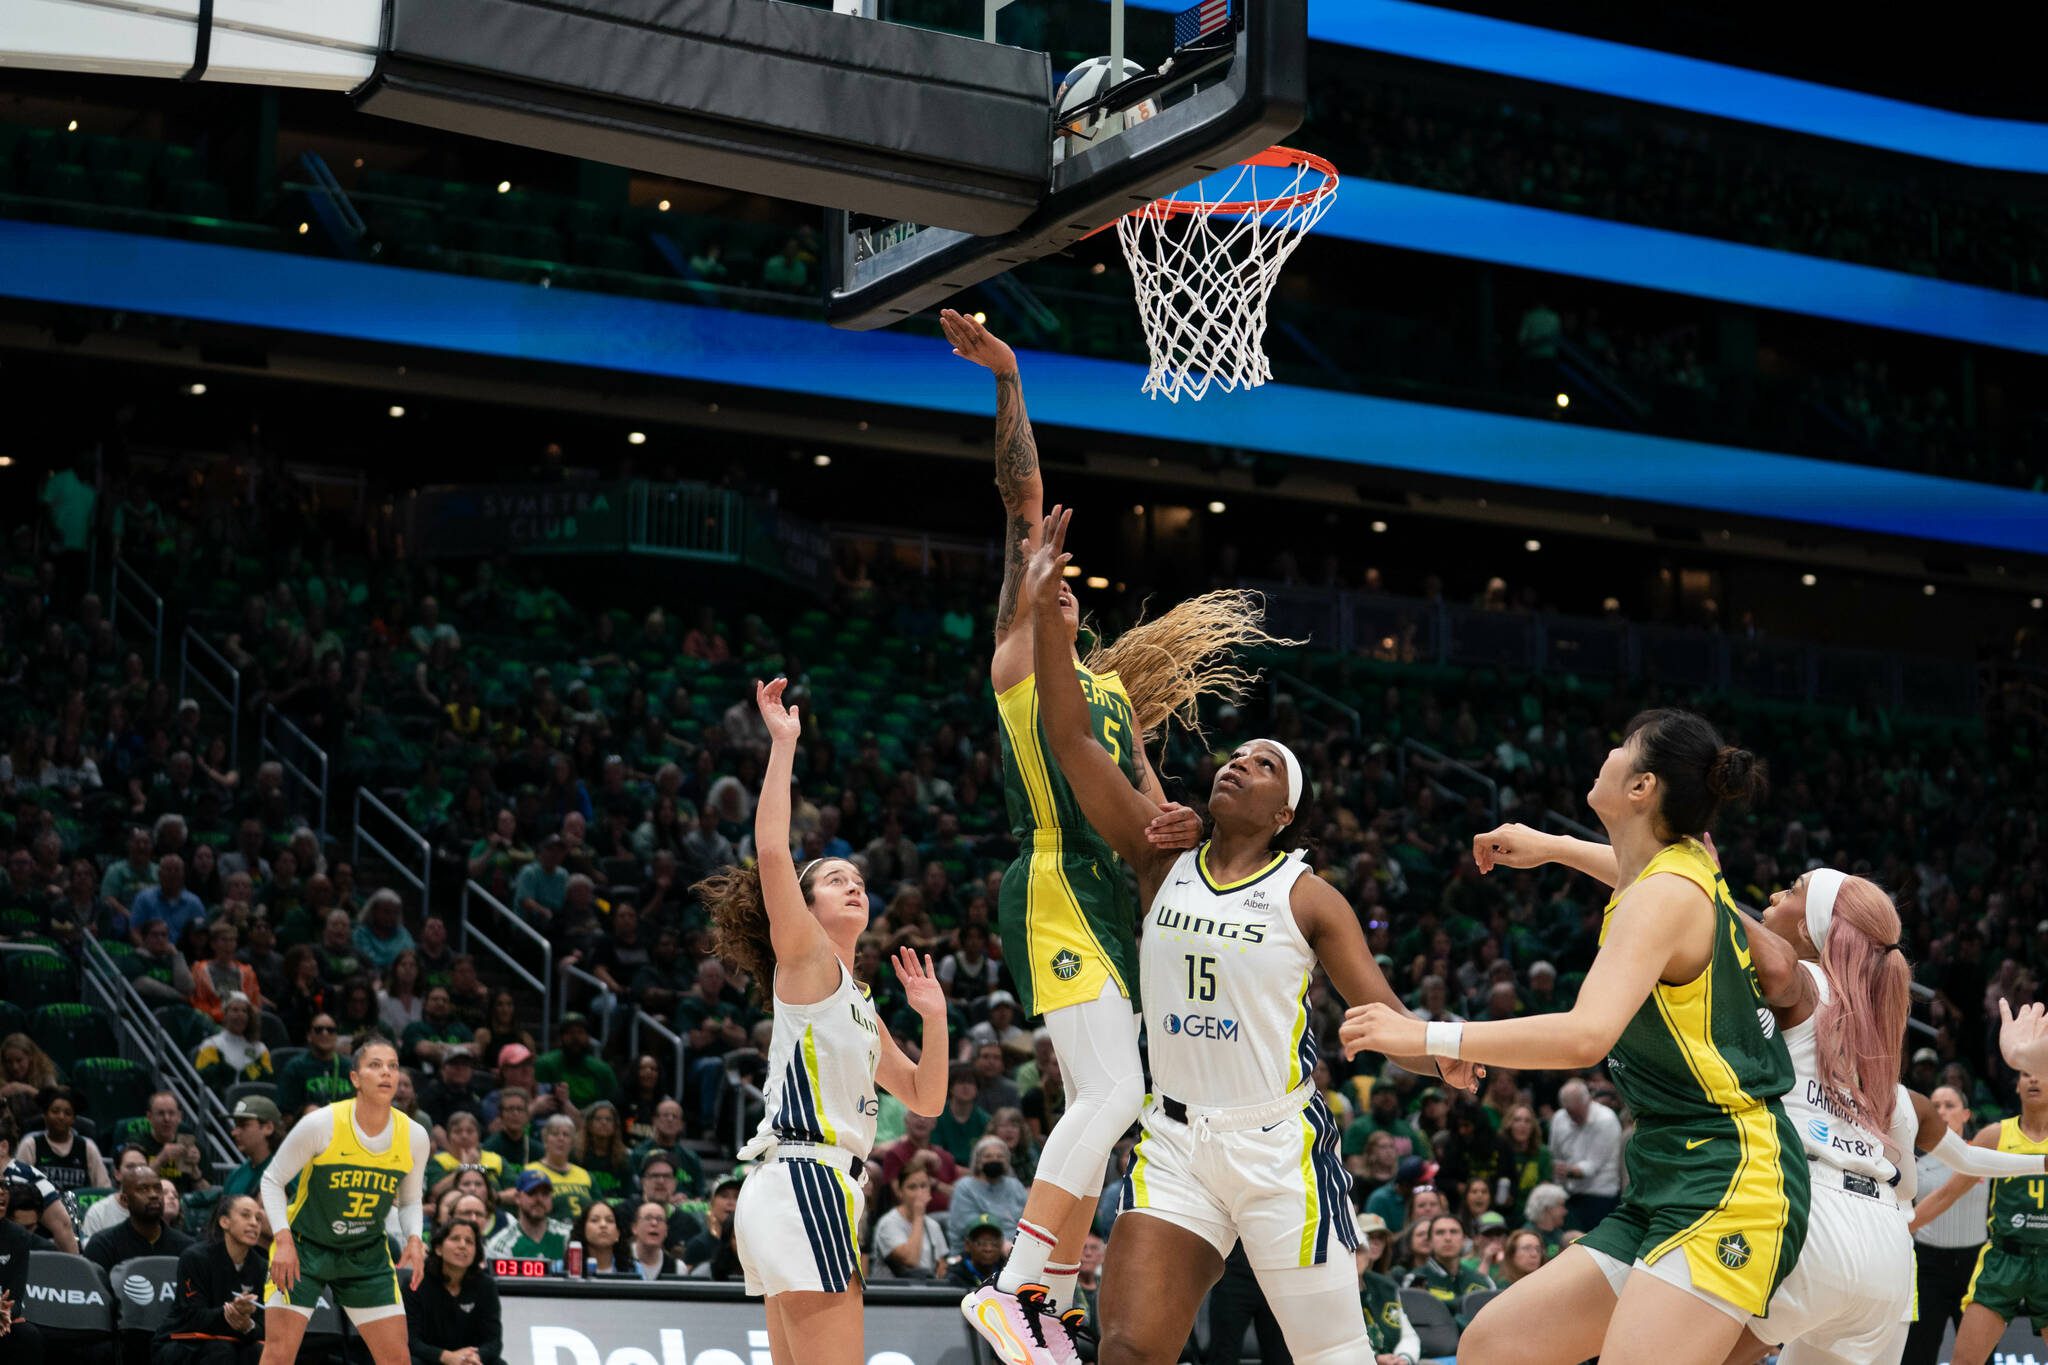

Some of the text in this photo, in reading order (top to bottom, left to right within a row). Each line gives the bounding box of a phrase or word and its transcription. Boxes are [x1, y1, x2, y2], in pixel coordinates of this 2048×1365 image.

[1103, 715, 1121, 765] 5
[1243, 898, 1270, 911] Albert
[1157, 905, 1267, 944] WINGS
[1185, 954, 1216, 1002] 15
[1183, 1013, 1239, 1042] GEM
[329, 1169, 398, 1194] SEATTLE
[2028, 1179, 2045, 1209] 4
[342, 1191, 380, 1218] 32
[568, 1195, 582, 1217] 5
[25, 1283, 104, 1306] WNBA
